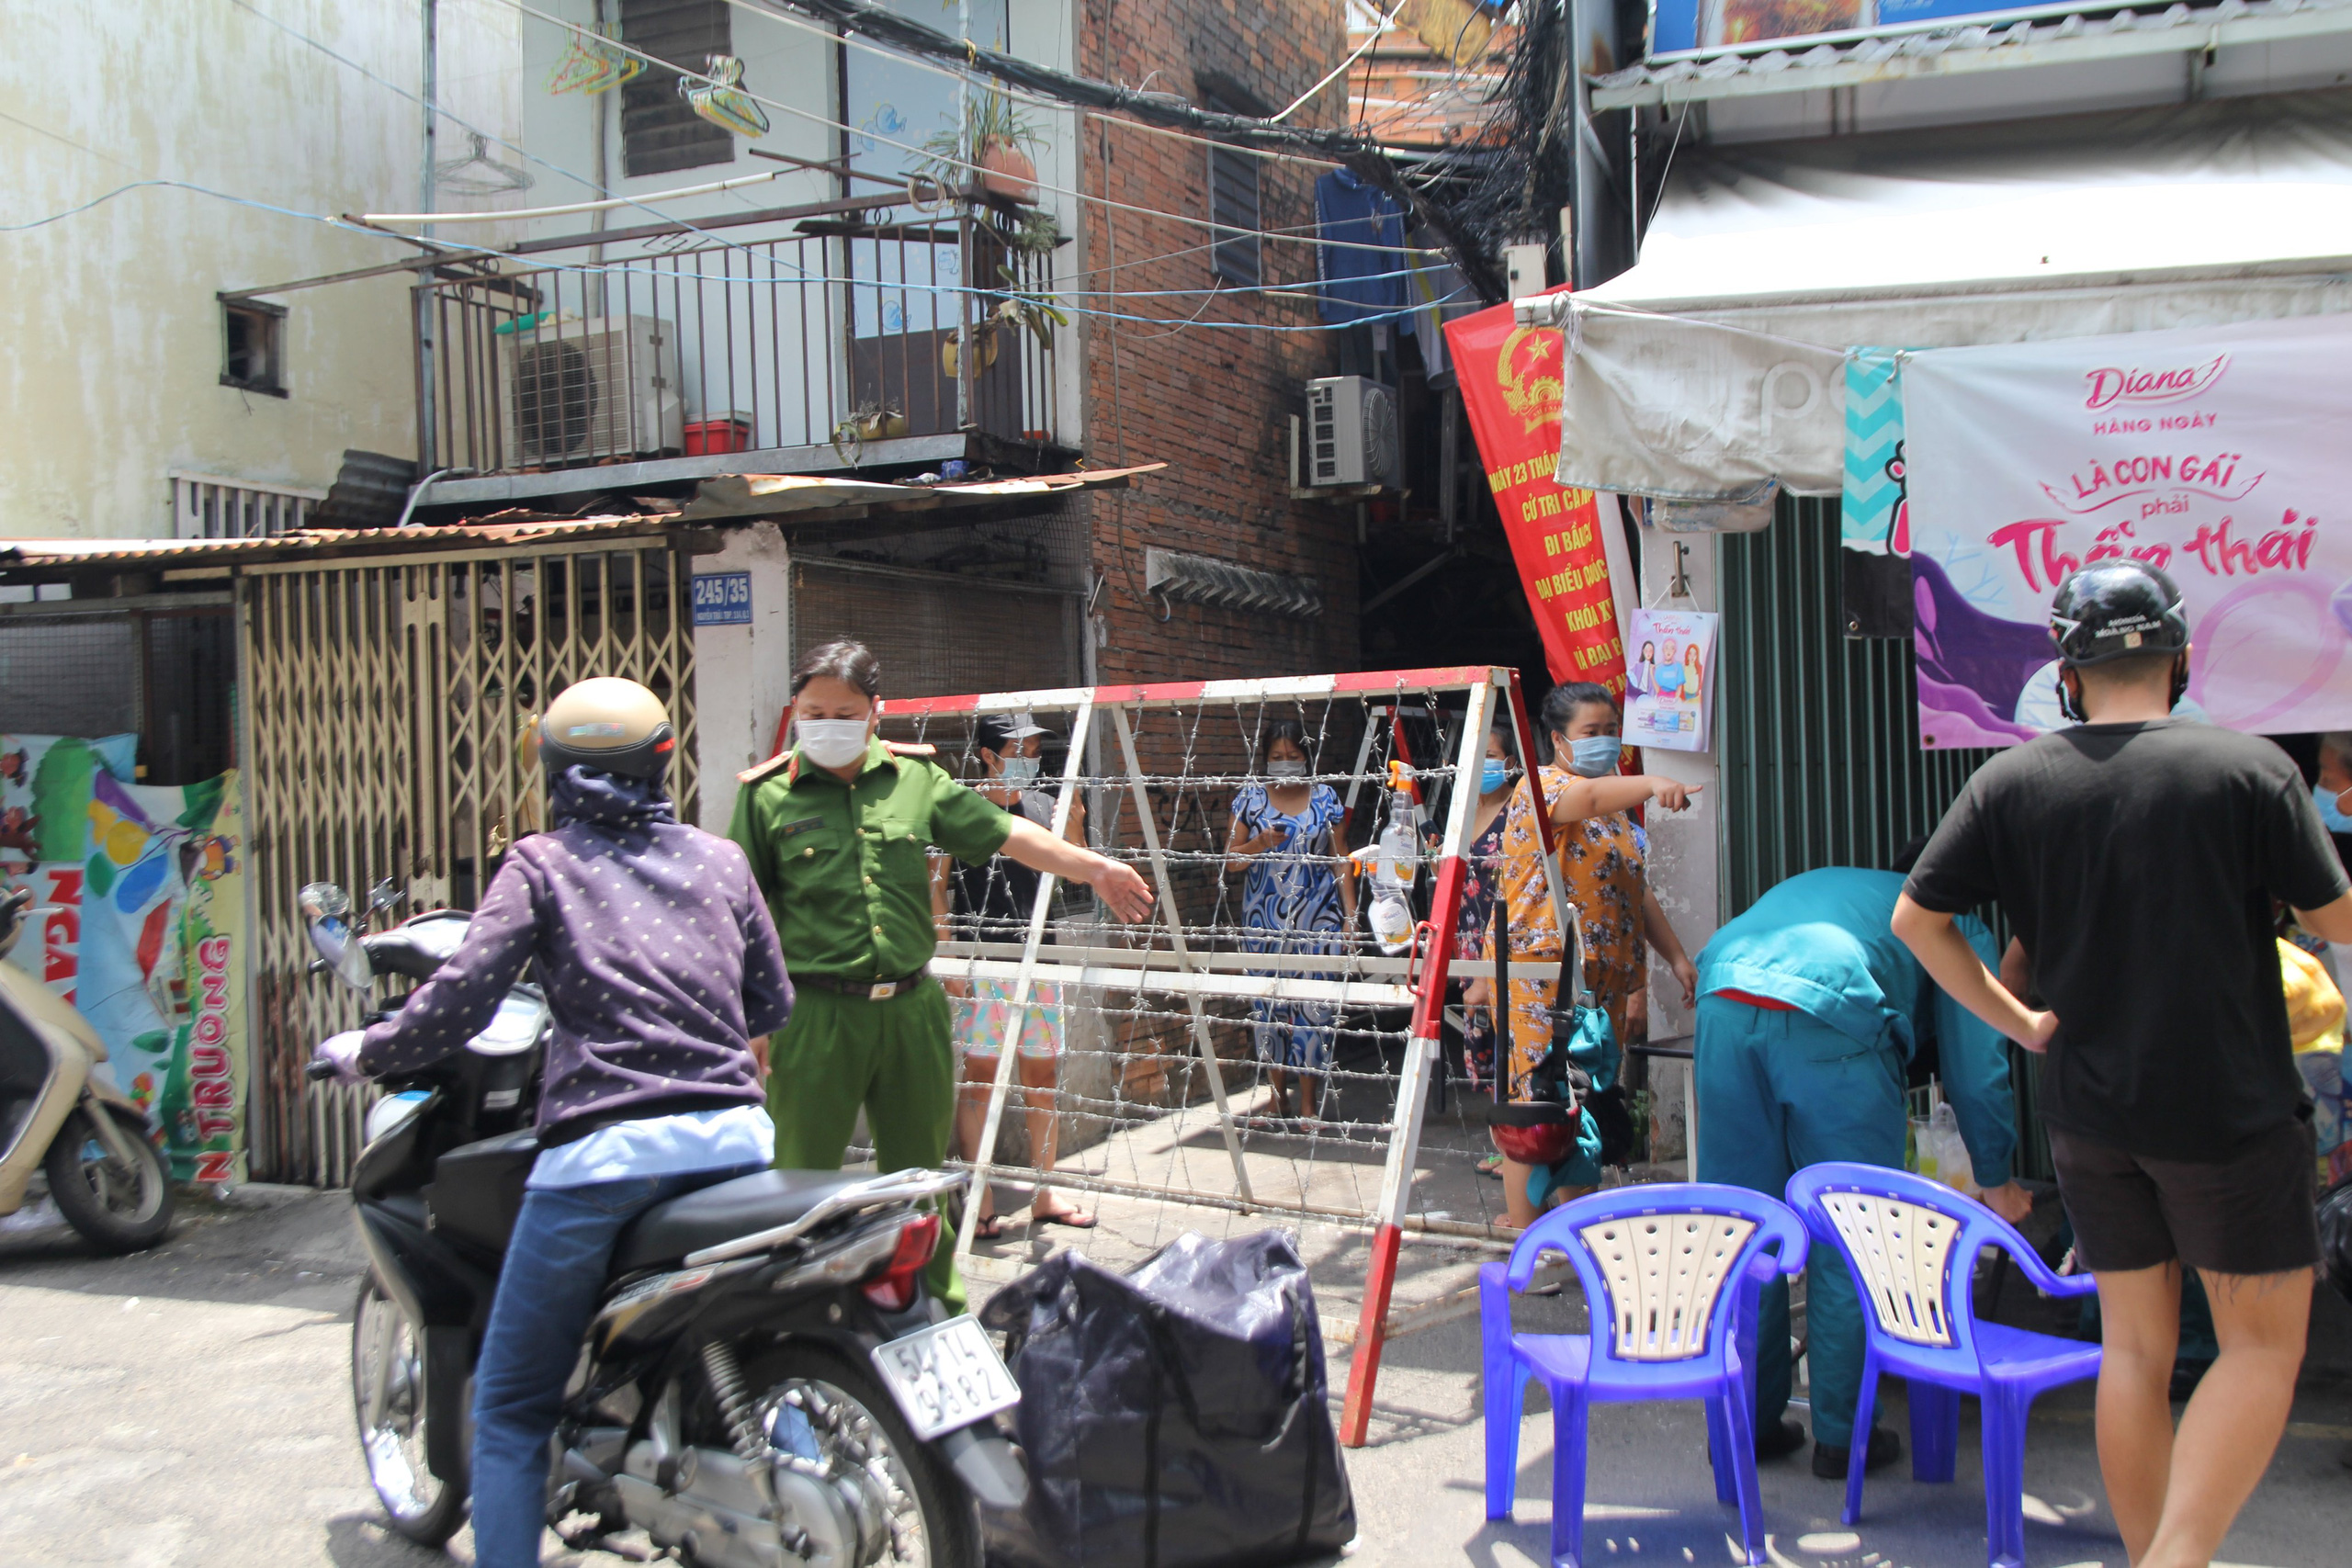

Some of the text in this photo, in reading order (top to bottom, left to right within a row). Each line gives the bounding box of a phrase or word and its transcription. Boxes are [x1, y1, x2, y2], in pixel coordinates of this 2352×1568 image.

[2086, 366, 2199, 410] Diana
[2093, 411, 2218, 436] HÀNG NGÀY
[1513, 462, 1528, 485] 23
[1528, 450, 1561, 479] THÁN
[2071, 453, 2243, 500] LÀ CON GÁI
[1538, 492, 1562, 517] TRI
[2141, 494, 2190, 521] phải
[2183, 508, 2318, 577] thái
[695, 577, 748, 605] 245/35
[1552, 562, 1584, 596] BIỂU
[1566, 603, 1600, 633] KHÓA
